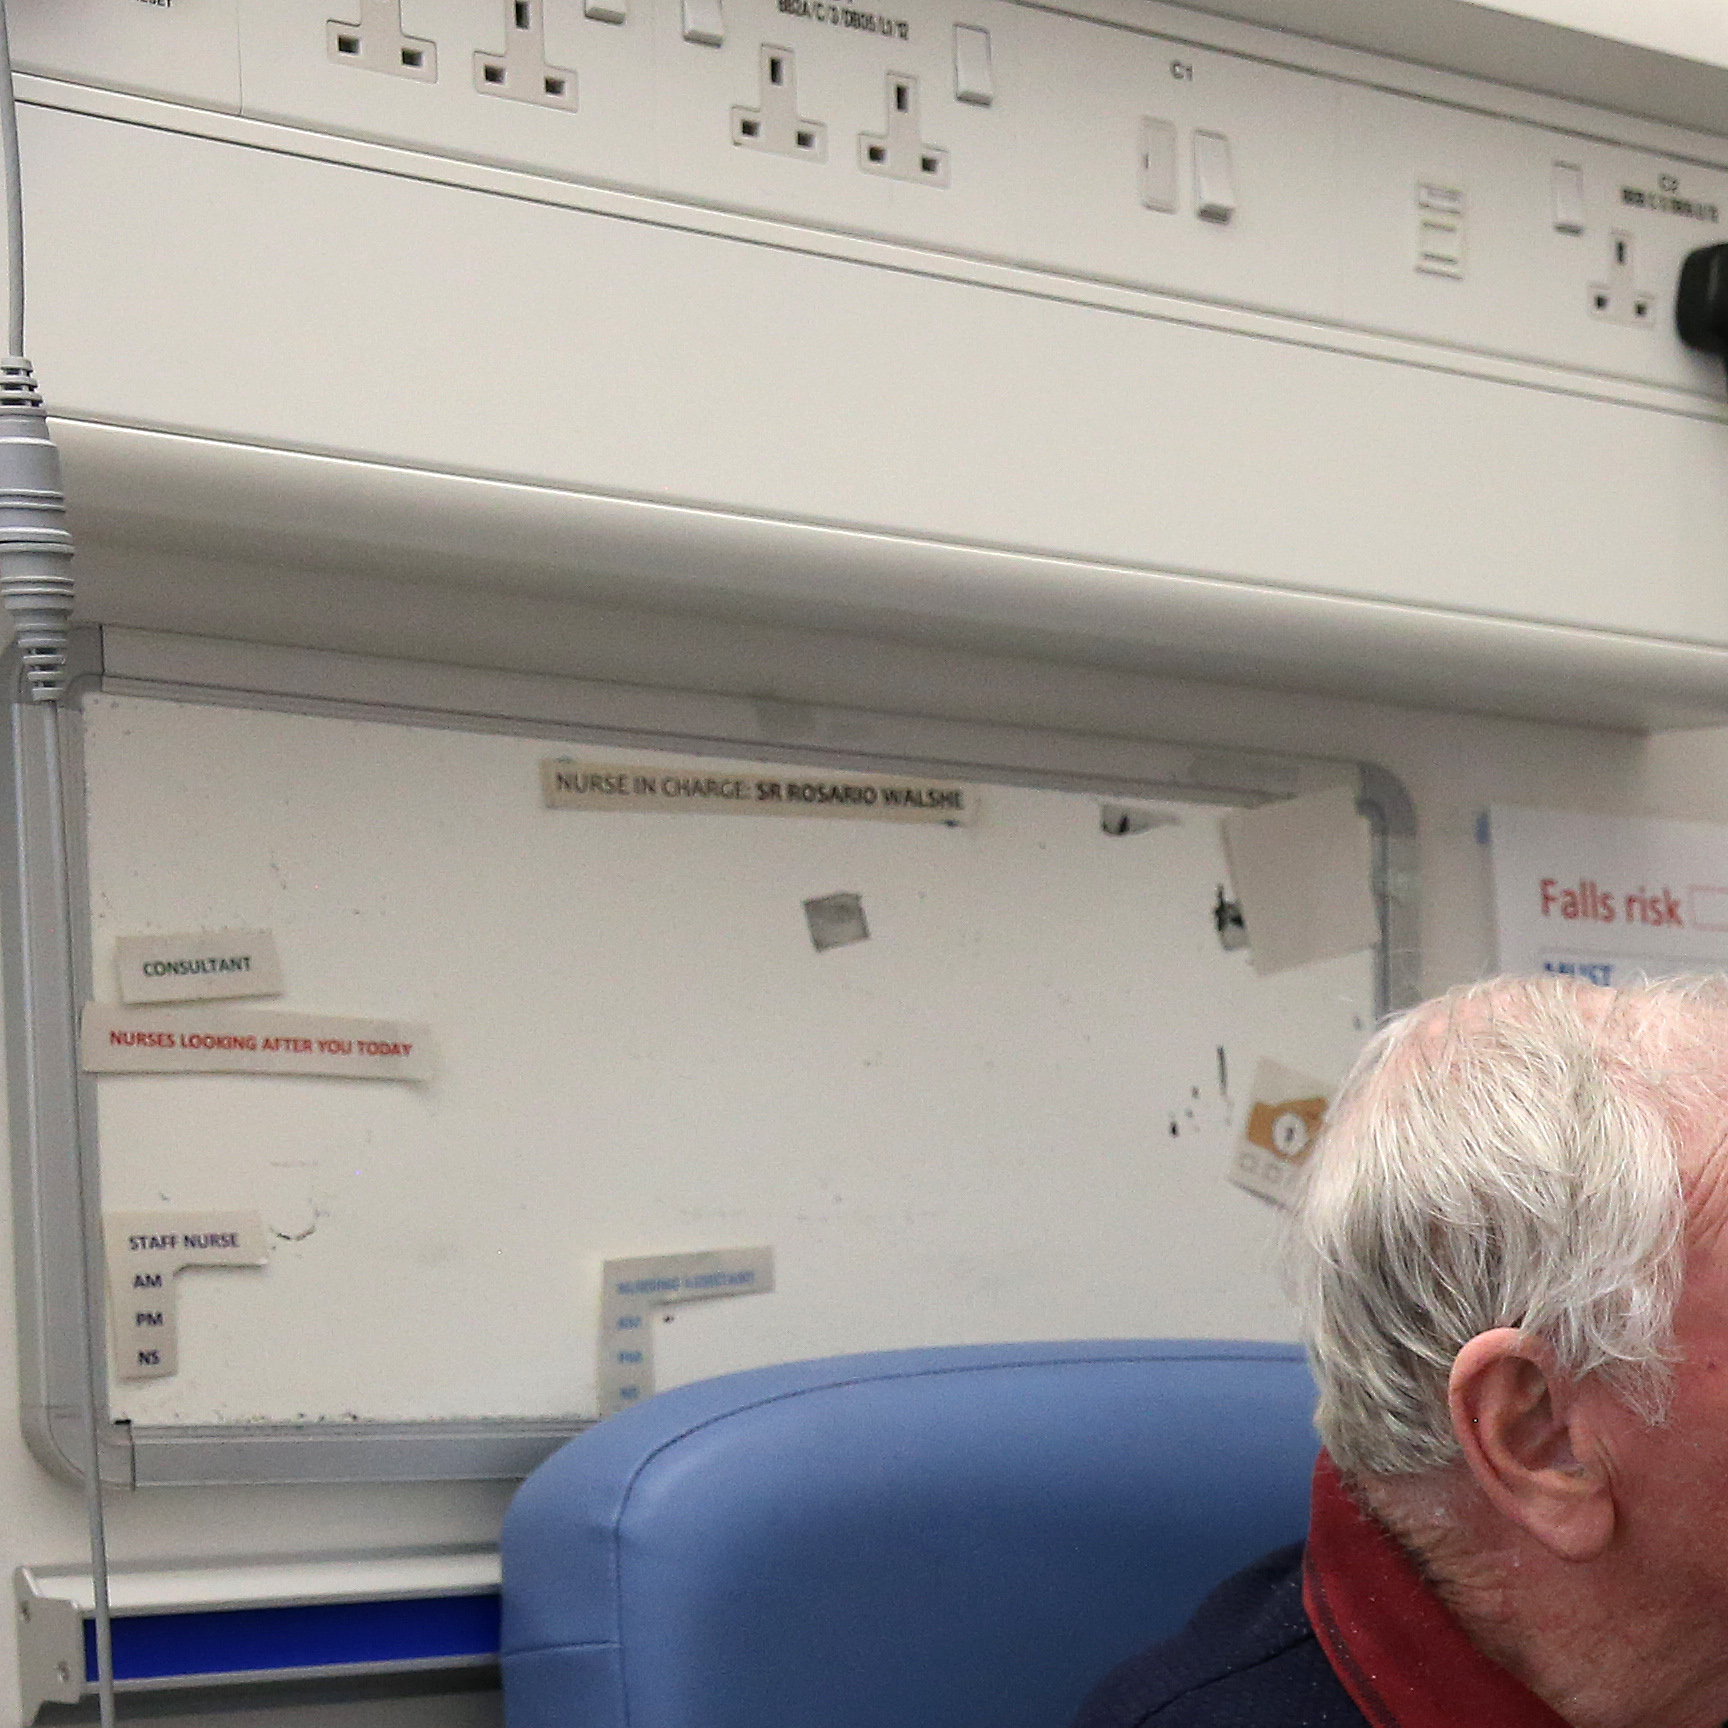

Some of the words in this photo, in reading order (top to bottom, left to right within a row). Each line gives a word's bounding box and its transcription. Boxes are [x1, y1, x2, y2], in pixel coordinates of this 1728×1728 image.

[556, 770, 632, 796] NURSE
[633, 774, 656, 794] IN
[756, 780, 783, 801] SR
[787, 783, 877, 805] ROSARIO
[1540, 880, 1615, 923] Falls
[1623, 886, 1683, 929] risk
[142, 957, 251, 977] CONSULTANT
[109, 1029, 176, 1050] NURSES
[180, 1033, 257, 1051] LOOKING
[262, 1036, 312, 1053] AFTER
[317, 1039, 352, 1054] YOU
[356, 1039, 414, 1057] TODAY
[128, 1234, 179, 1251] STAFF
[183, 1230, 241, 1250] NURSE
[133, 1273, 163, 1288] AM
[136, 1312, 164, 1327] PM
[138, 1350, 161, 1366] NS
